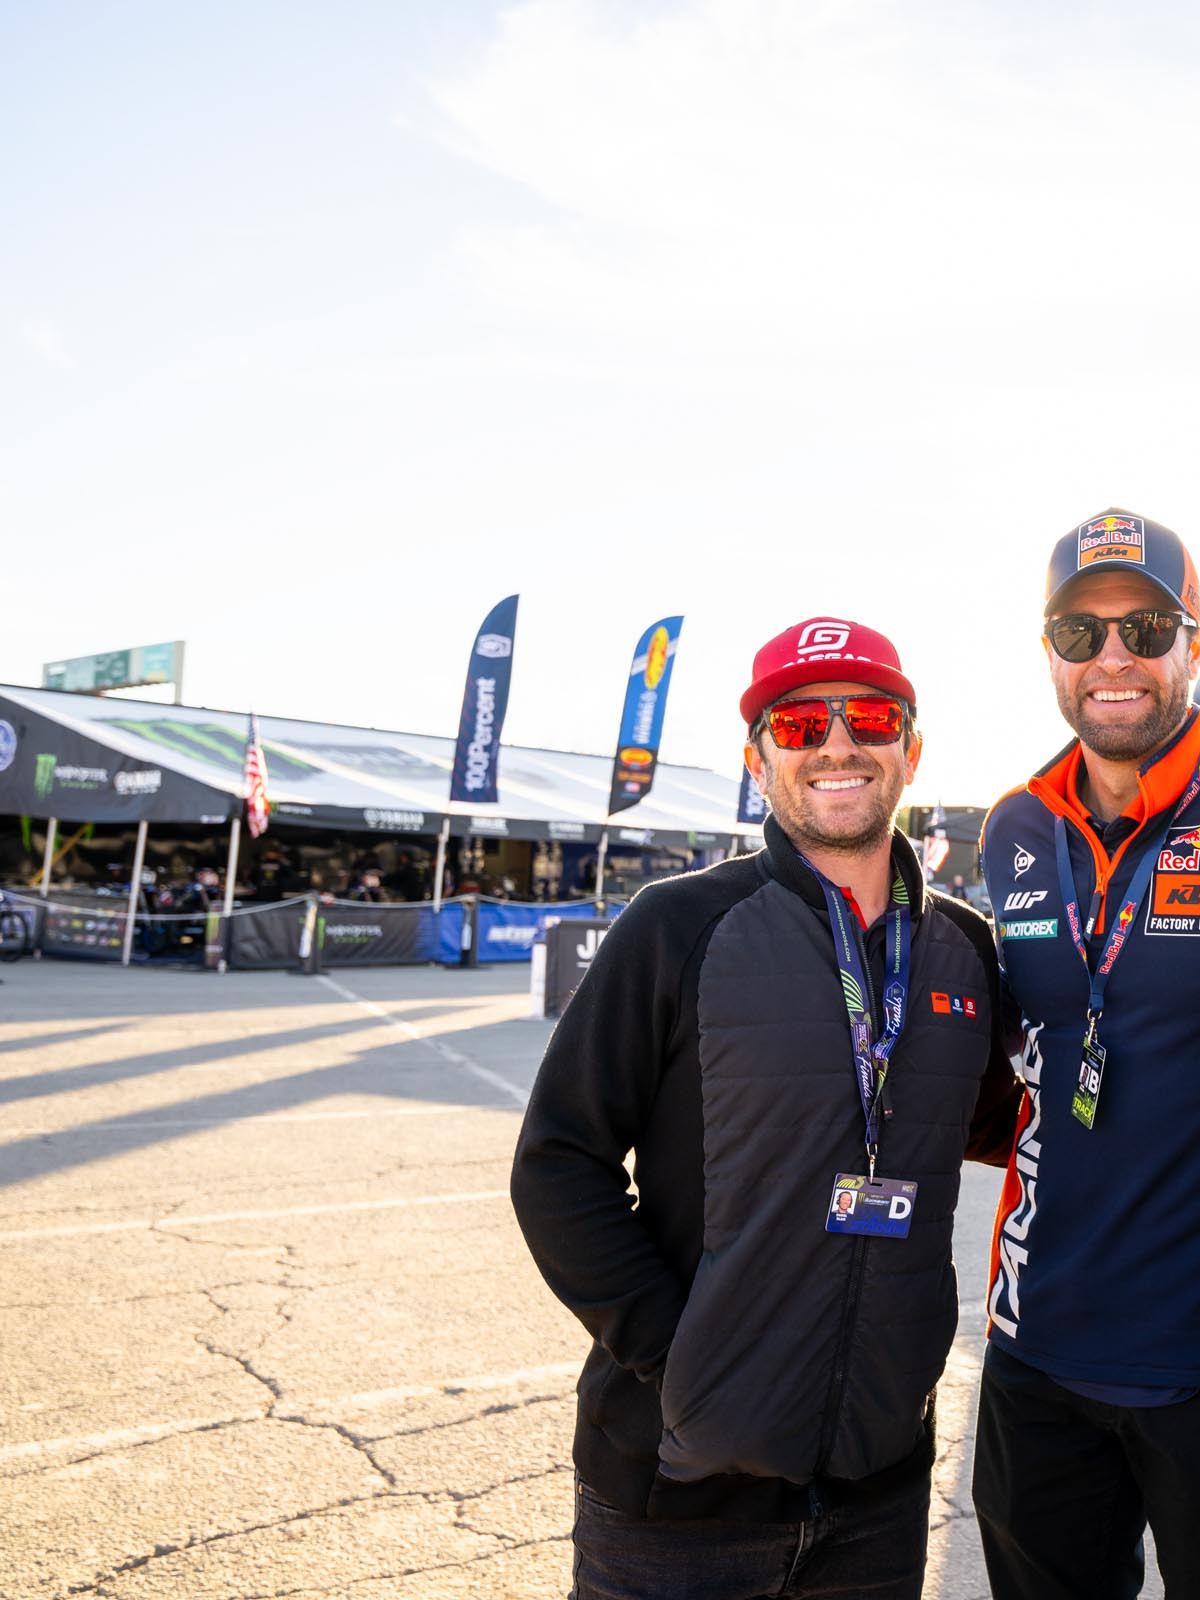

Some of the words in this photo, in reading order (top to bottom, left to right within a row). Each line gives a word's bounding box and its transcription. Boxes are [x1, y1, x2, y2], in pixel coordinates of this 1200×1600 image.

[1081, 533, 1109, 551] Red
[1111, 532, 1141, 545] Bull
[1093, 548, 1128, 558] KTM
[1158, 849, 1200, 871] Red
[1004, 890, 1048, 911] WP
[1006, 921, 1054, 938] MOTOREX
[1150, 918, 1196, 931] FACTORY
[1072, 1096, 1094, 1121] TRACK
[888, 1195, 912, 1220] D
